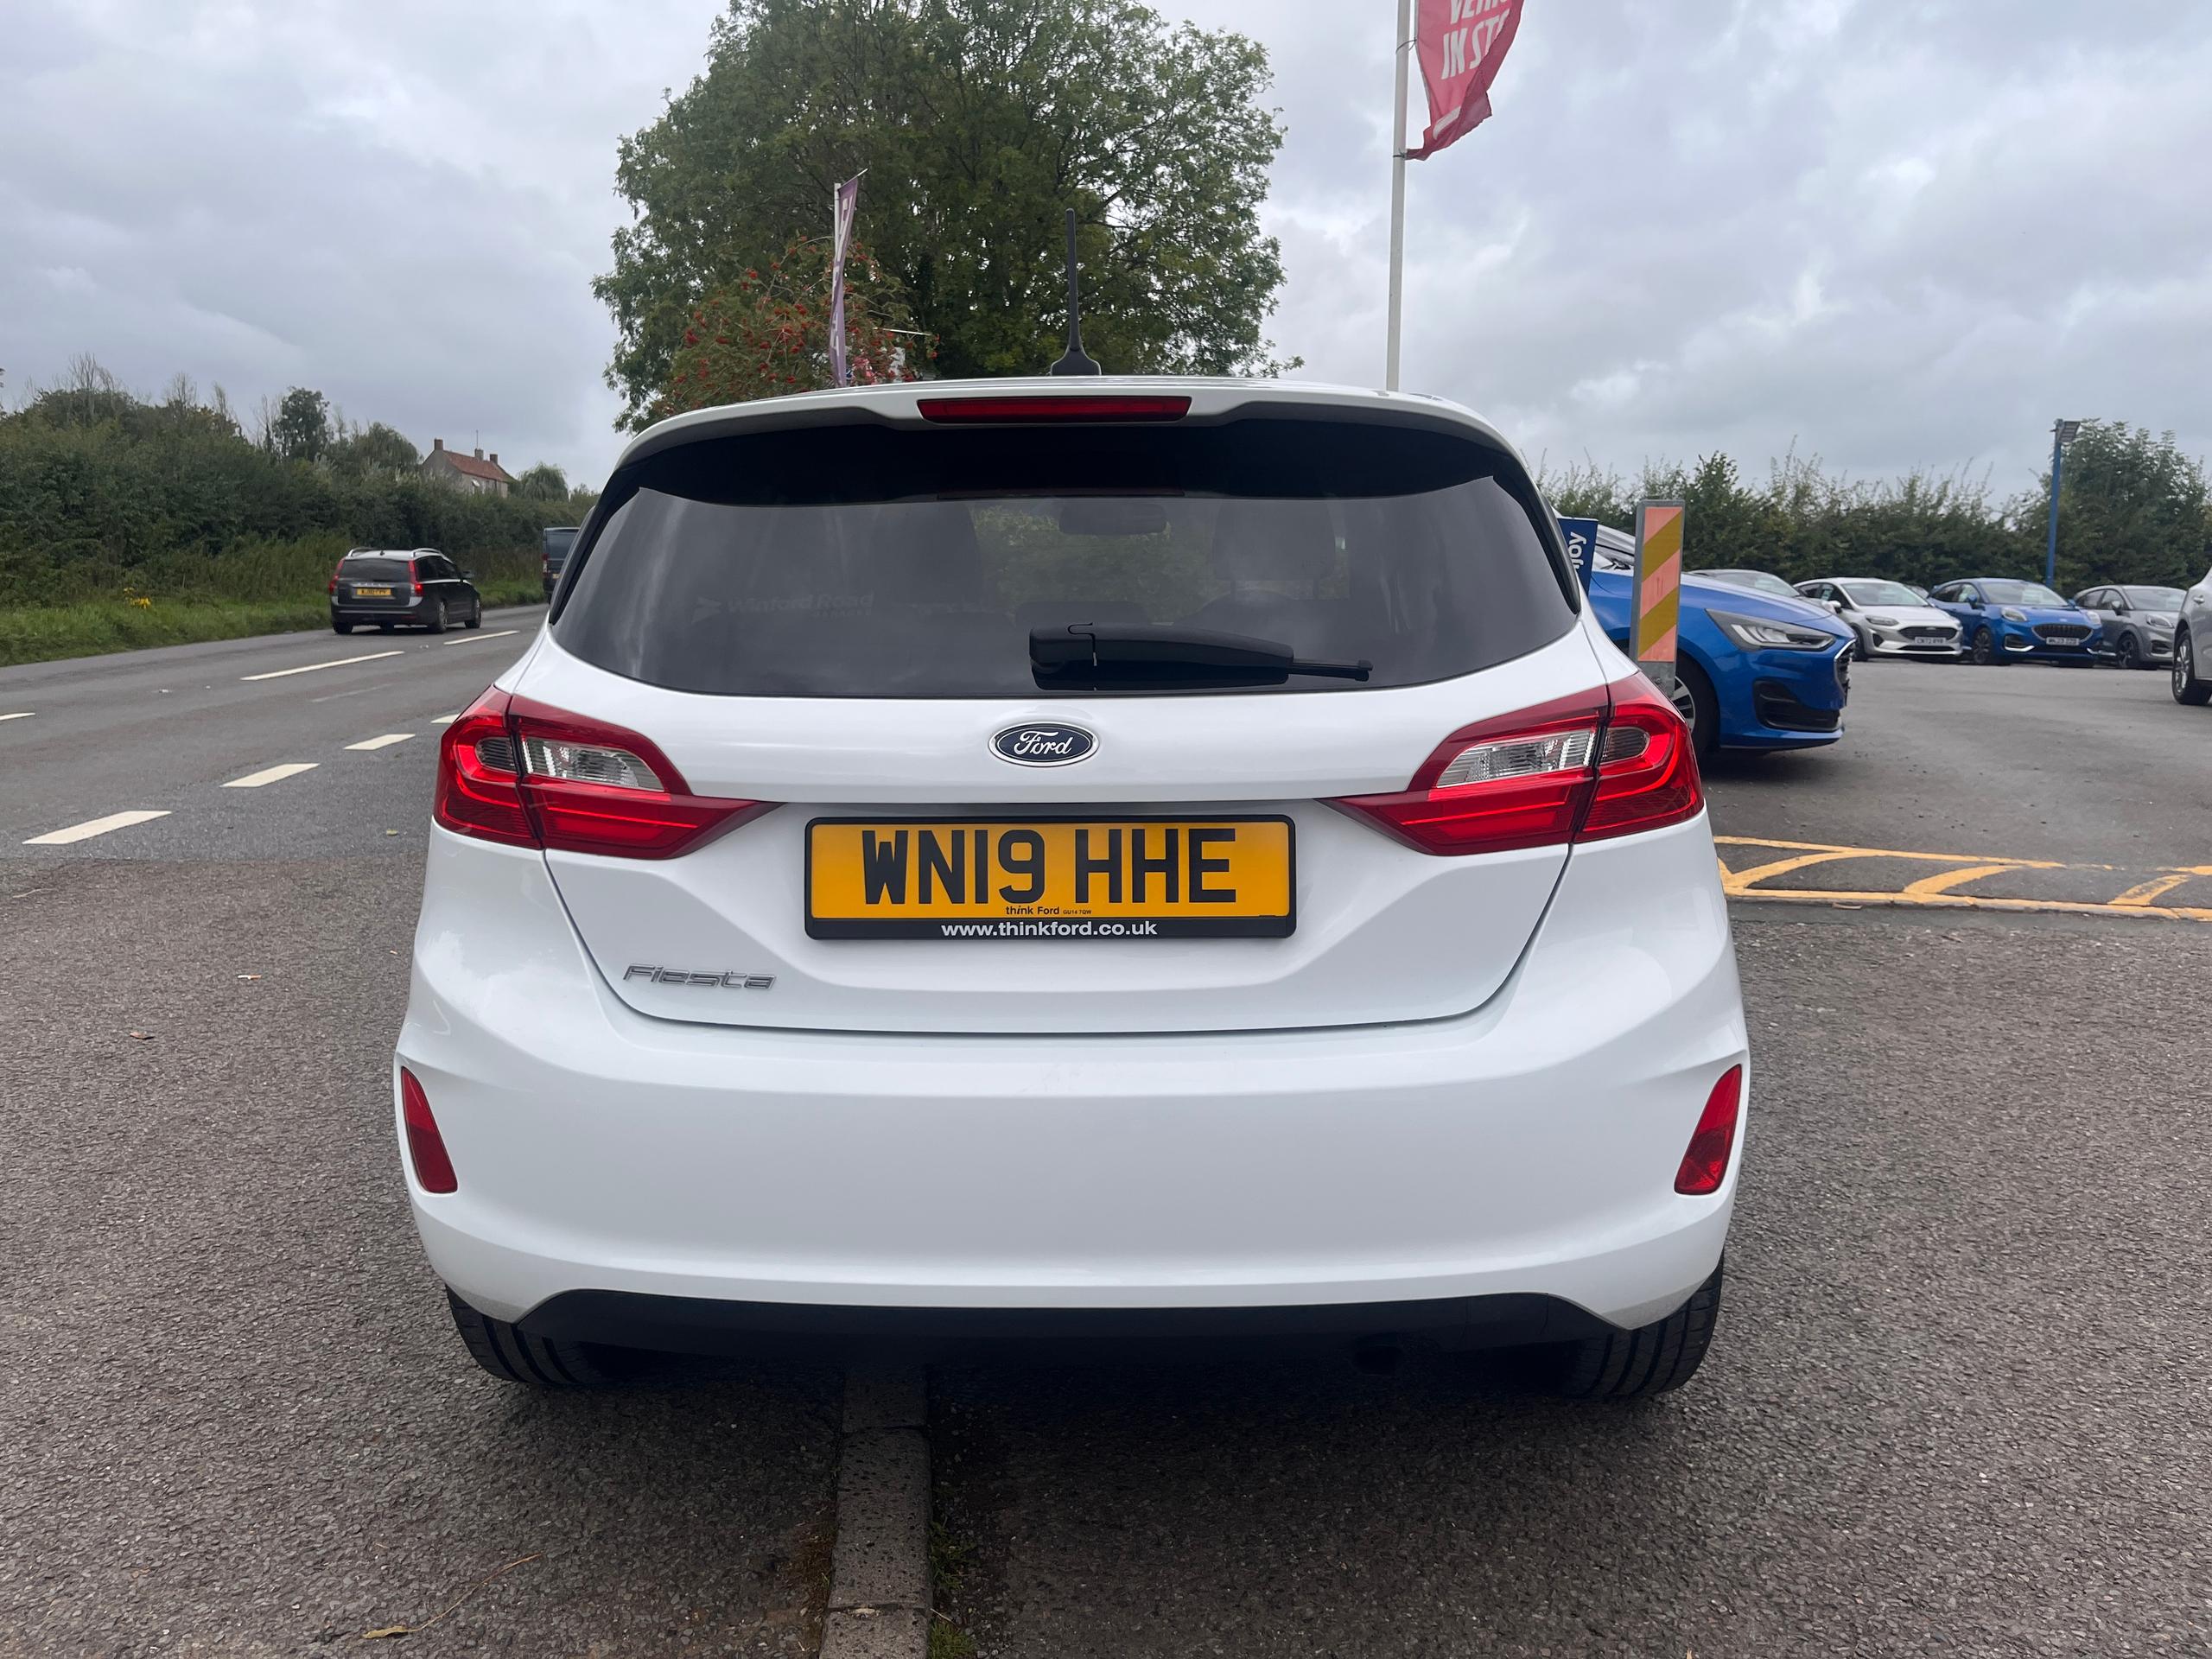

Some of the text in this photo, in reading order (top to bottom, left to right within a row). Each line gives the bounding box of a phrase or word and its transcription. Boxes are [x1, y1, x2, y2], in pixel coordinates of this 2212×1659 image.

[1441, 28, 1468, 79] IN
[1014, 730, 1073, 755] Ford
[861, 828, 1237, 905] WN19 HHE
[1005, 905, 1033, 915] think
[1037, 906, 1060, 915] Ford
[941, 918, 1158, 937] www.thinkford.co.uk
[623, 963, 778, 990] Fiesta
